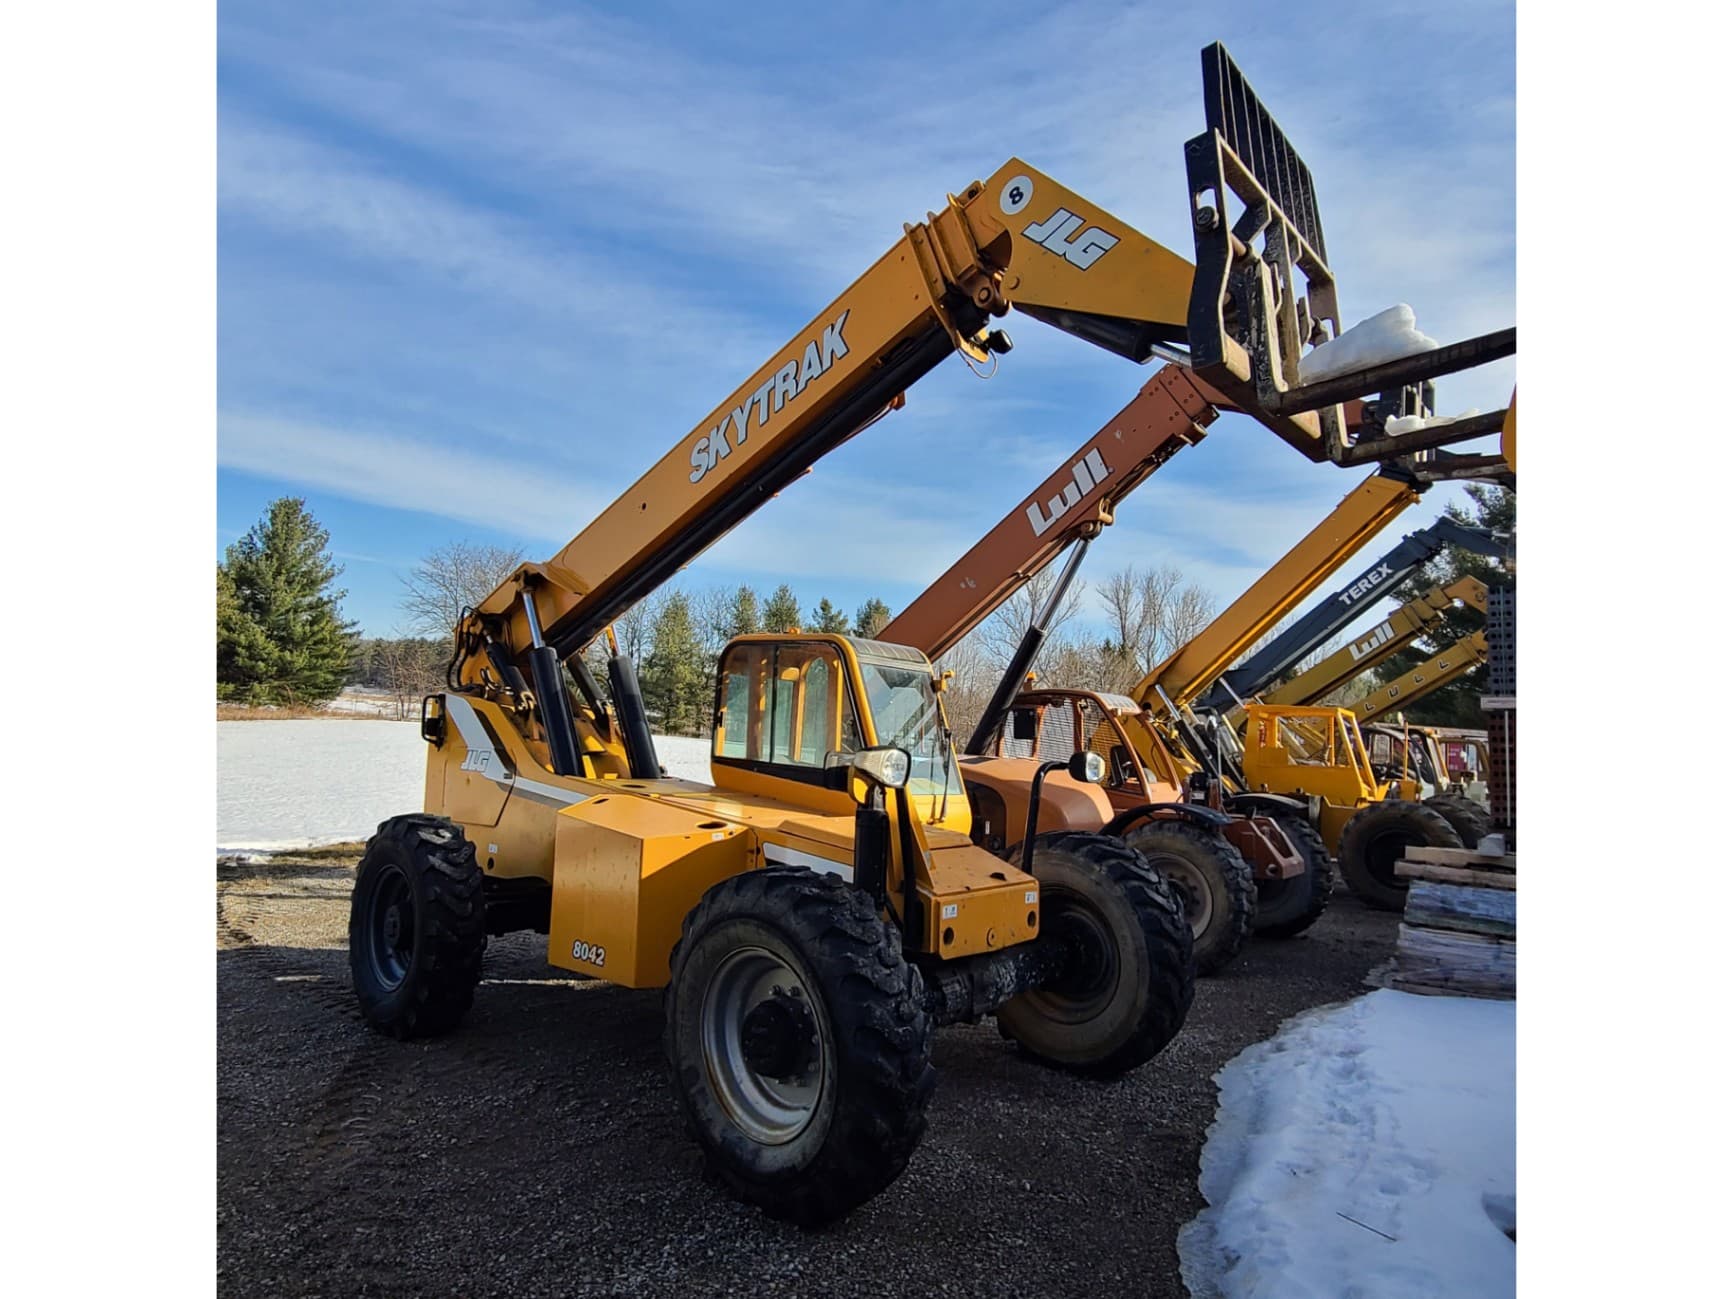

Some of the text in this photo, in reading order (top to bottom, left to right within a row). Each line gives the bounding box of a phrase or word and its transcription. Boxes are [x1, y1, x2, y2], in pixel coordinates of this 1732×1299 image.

[1009, 186, 1024, 205] 8
[1020, 207, 1121, 272] JLG
[689, 309, 850, 484] SKYTRAK
[1026, 447, 1109, 537] Lull
[1338, 562, 1394, 605] TEREX
[1348, 621, 1395, 660] Lull
[460, 749, 491, 772] JLG
[572, 939, 606, 967] 8042
